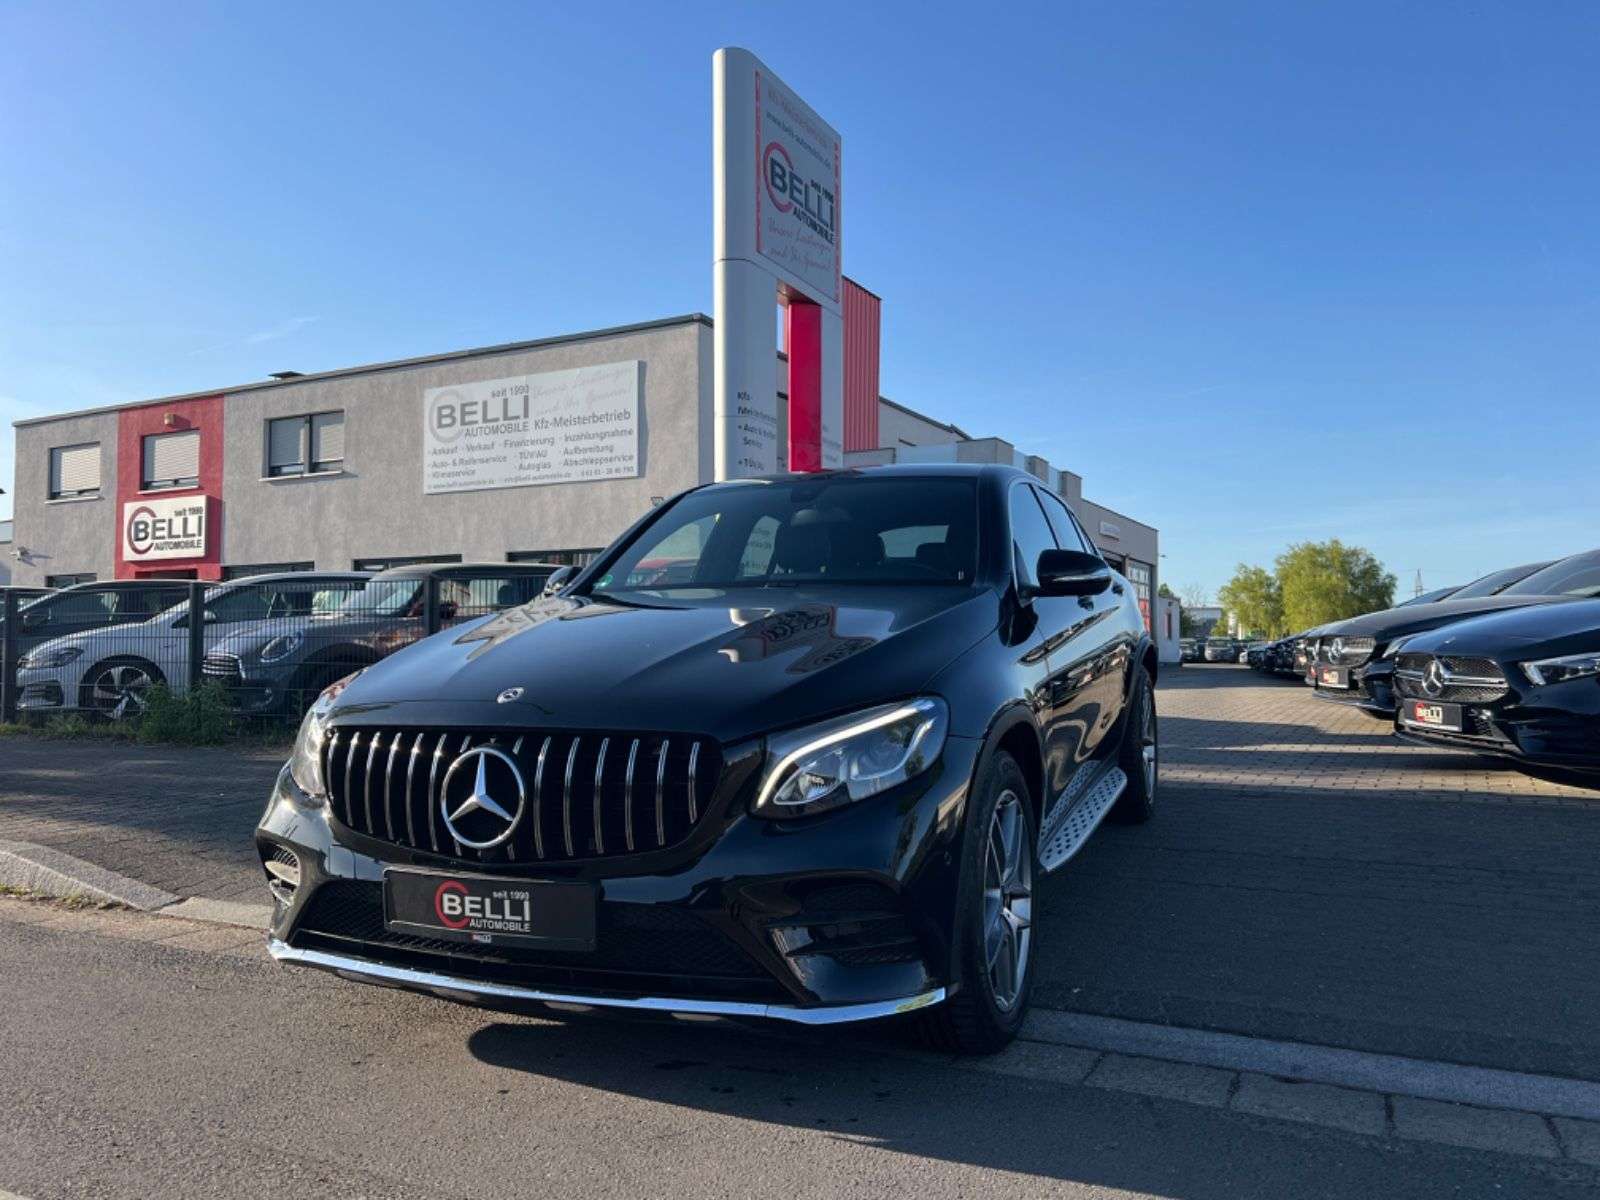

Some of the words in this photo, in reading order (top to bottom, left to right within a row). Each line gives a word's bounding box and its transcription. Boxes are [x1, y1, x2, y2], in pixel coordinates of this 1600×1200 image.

[769, 156, 834, 232] BELLI
[793, 206, 834, 245] AUTOMOBILE
[436, 395, 530, 429] BELLI
[465, 420, 530, 438] AUTOMOBILE
[534, 409, 631, 430] Kfz-Meisterbetrieb
[503, 436, 555, 449] Finanzierung
[133, 516, 203, 542] BELLI
[154, 539, 203, 551] AUTOMOBILE
[441, 892, 531, 921] BELLI
[469, 918, 531, 933] AUTOMOBILE
